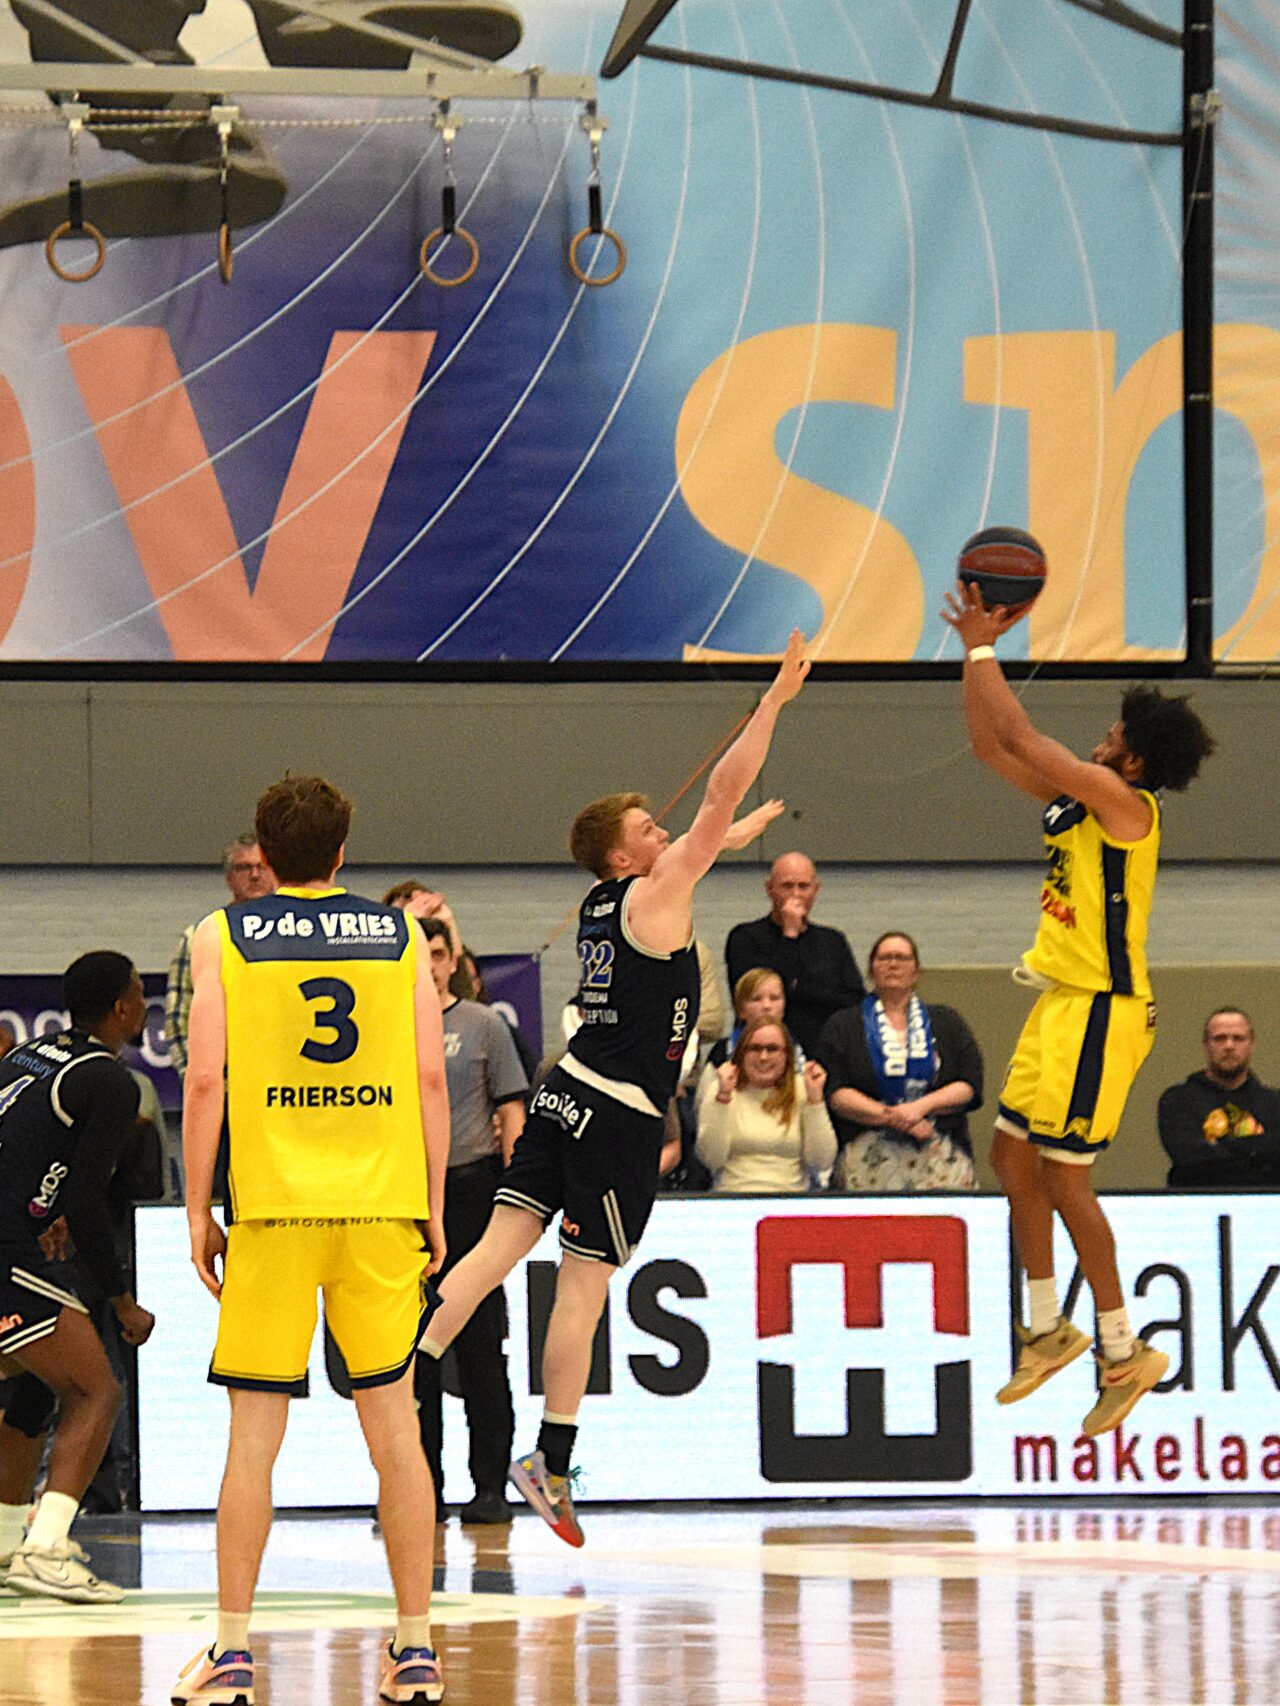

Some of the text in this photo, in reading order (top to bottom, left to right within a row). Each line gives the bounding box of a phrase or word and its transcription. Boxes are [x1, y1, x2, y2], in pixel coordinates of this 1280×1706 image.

[277, 911, 315, 937] de
[319, 912, 397, 938] VRIES
[298, 976, 360, 1065] 3
[670, 997, 689, 1043] MDS
[10, 1053, 55, 1080] century
[266, 1085, 393, 1108] FRIERSON
[31, 1161, 69, 1209] MDS
